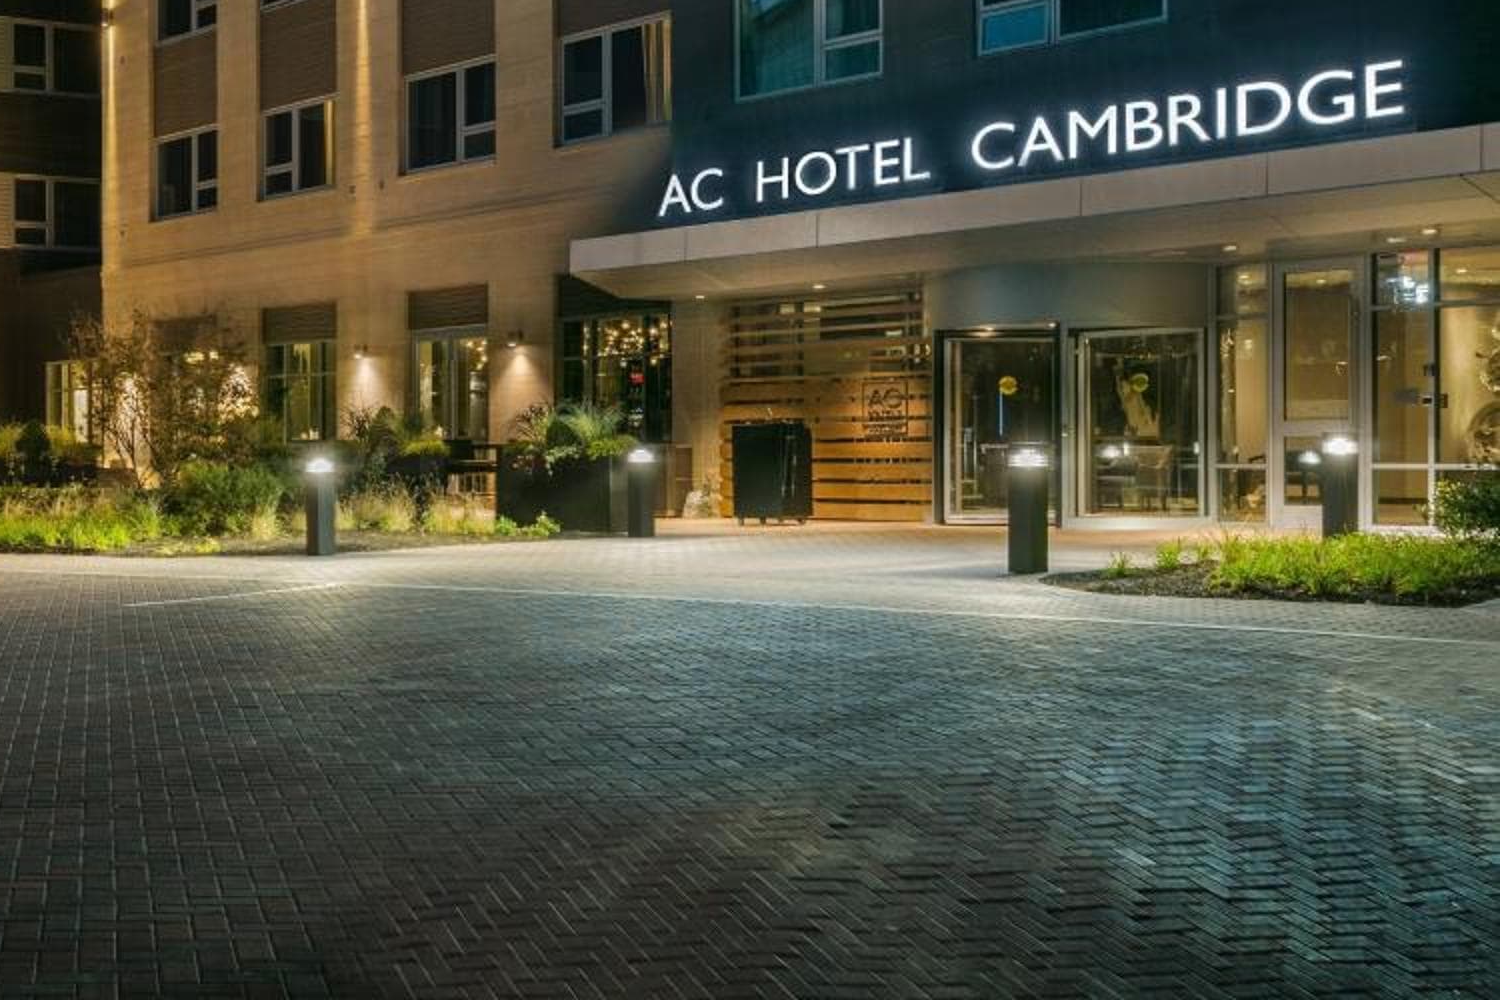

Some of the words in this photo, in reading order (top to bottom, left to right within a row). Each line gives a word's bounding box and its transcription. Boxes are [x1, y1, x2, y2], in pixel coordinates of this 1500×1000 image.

[658, 167, 724, 217] AC
[755, 136, 931, 204] HOTEL
[970, 59, 1405, 171] CAMBRIDGE
